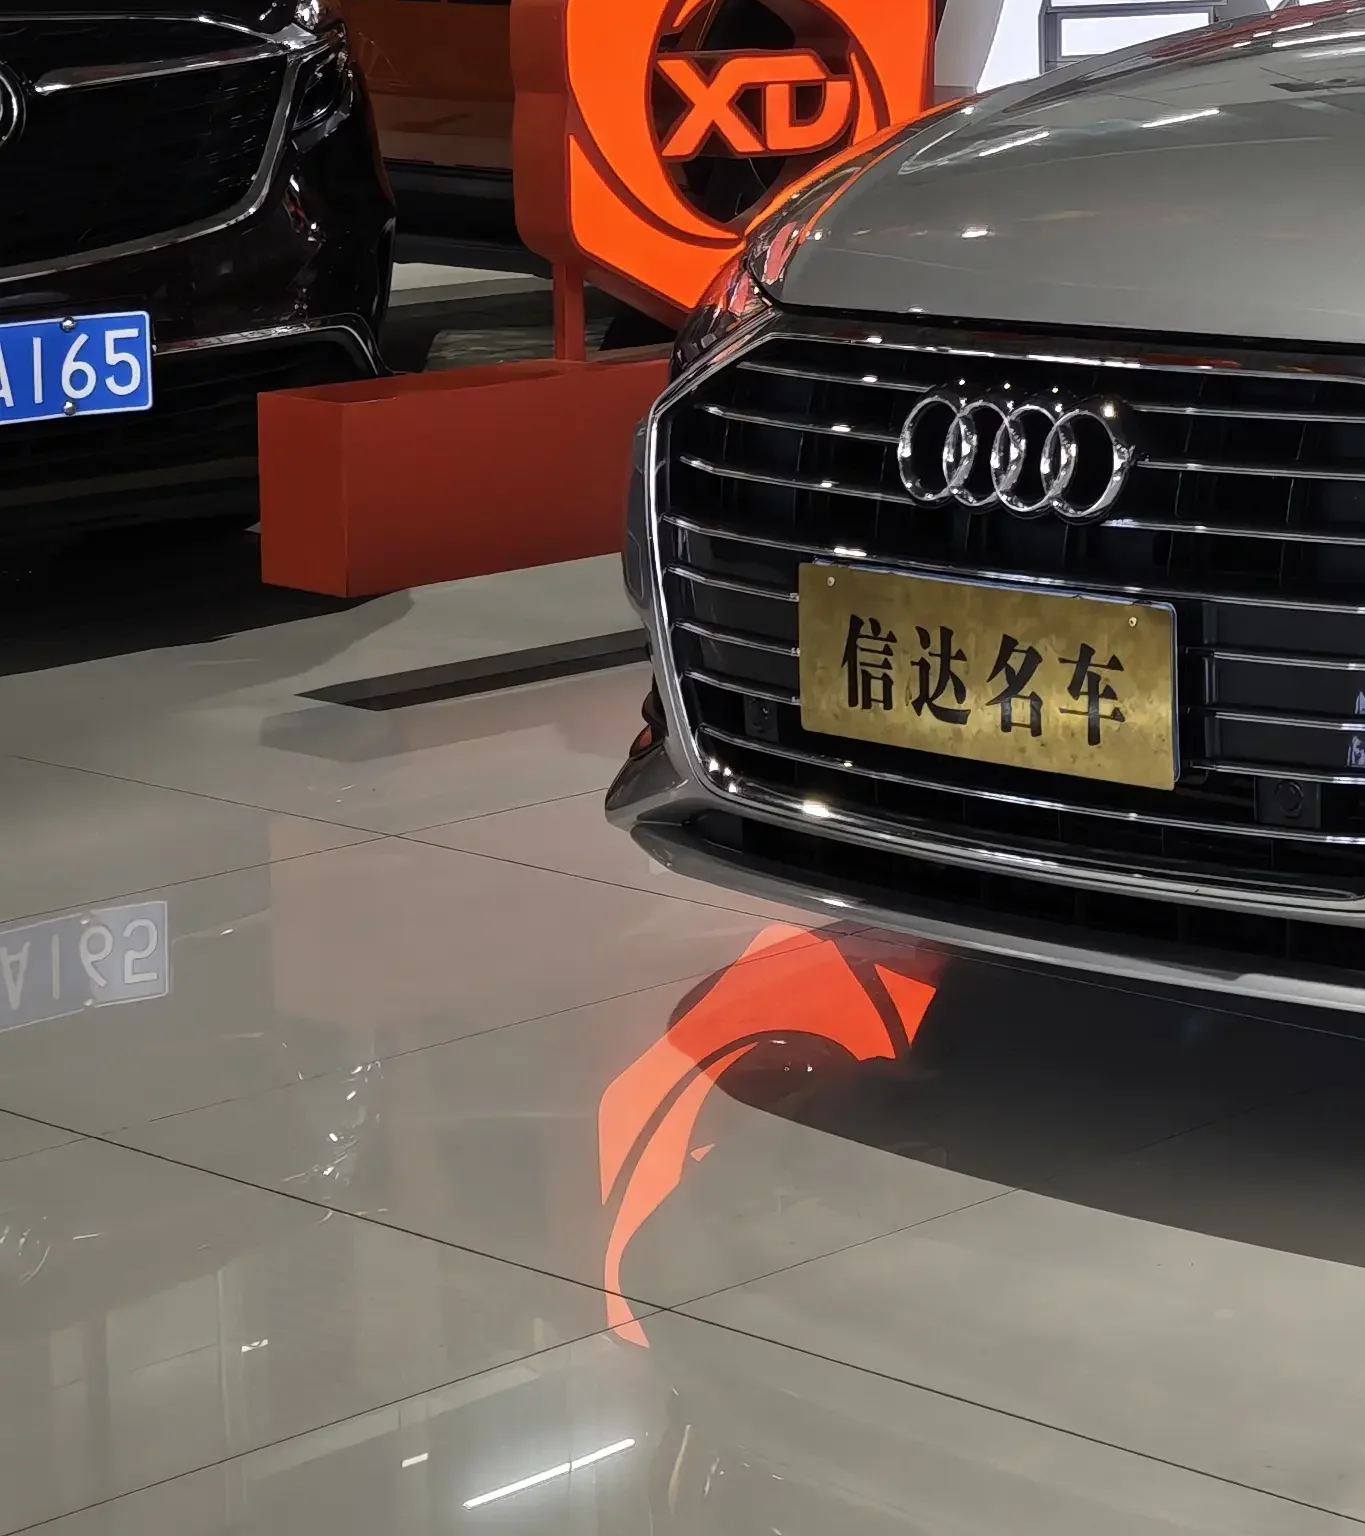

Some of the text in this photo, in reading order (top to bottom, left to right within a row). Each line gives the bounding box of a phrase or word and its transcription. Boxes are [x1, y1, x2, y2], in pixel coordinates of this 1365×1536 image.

[657, 56, 850, 158] XD
[841, 614, 1128, 748] 信达名车
